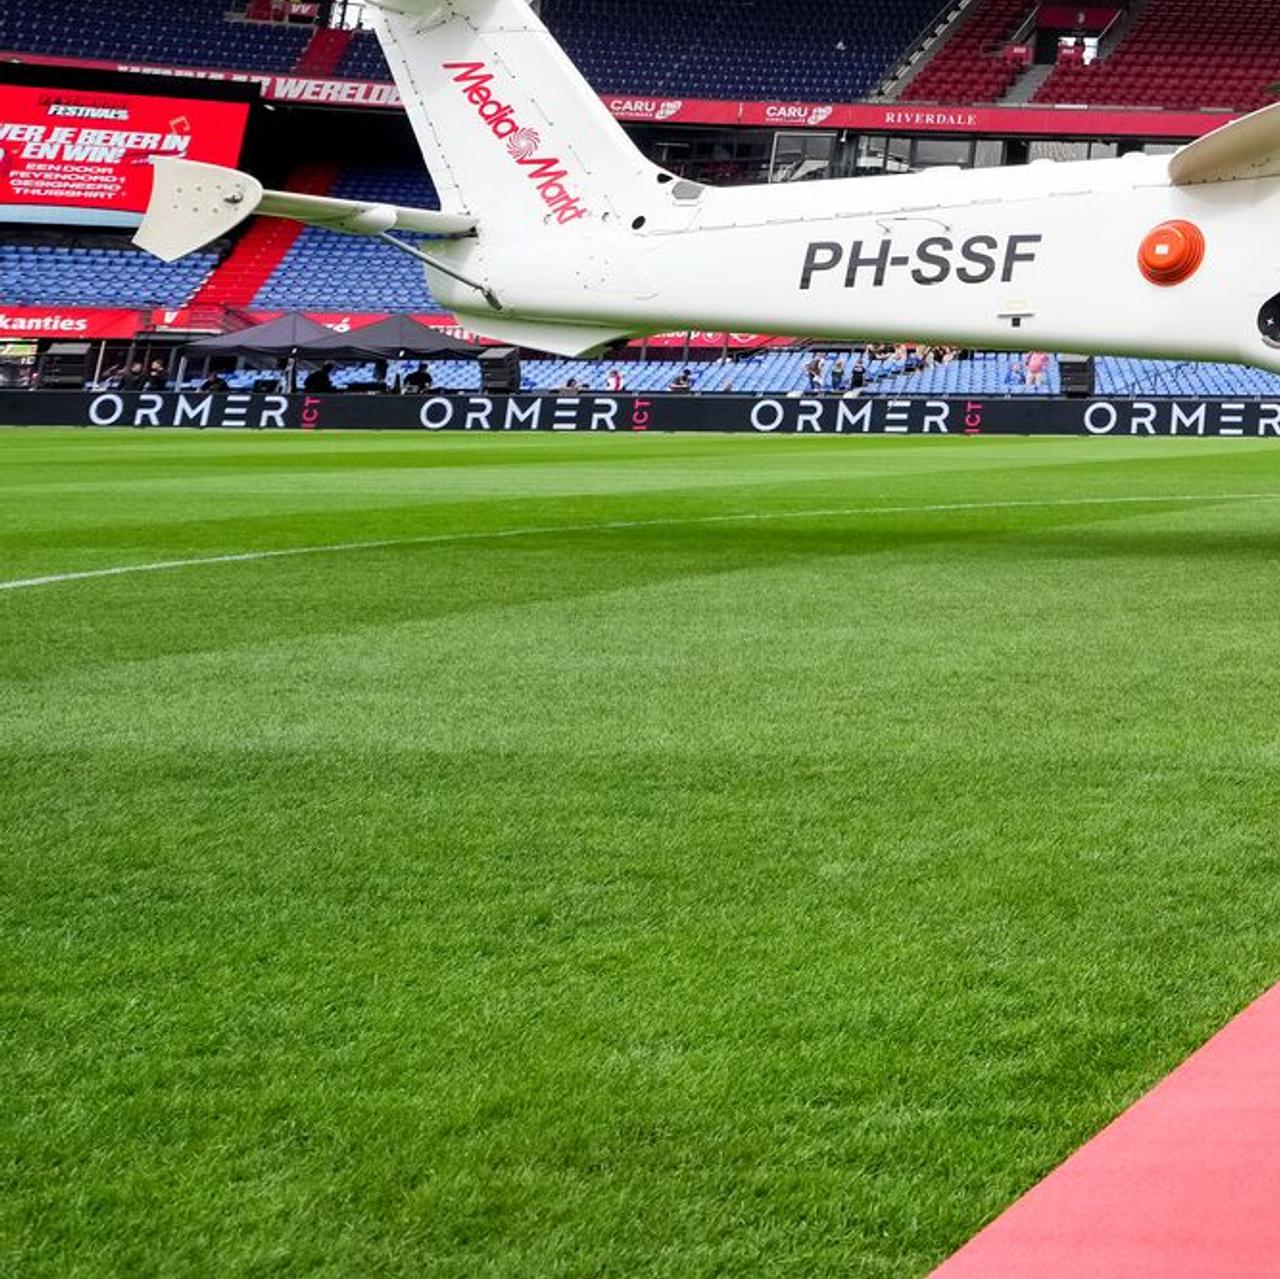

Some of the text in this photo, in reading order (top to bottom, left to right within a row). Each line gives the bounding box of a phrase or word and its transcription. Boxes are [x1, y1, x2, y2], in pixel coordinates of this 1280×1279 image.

[610, 100, 656, 112] CARU
[766, 106, 808, 118] CARU
[884, 112, 978, 125] RIVERDALE
[21, 143, 60, 160] EN
[77, 129, 161, 149] BEKER
[161, 134, 191, 151] IN
[442, 62, 587, 225] Media Markt
[799, 234, 1042, 290] PH-SSF
[89, 394, 290, 428] ORMER
[420, 397, 618, 430] ORMER
[750, 400, 950, 432] ORMER
